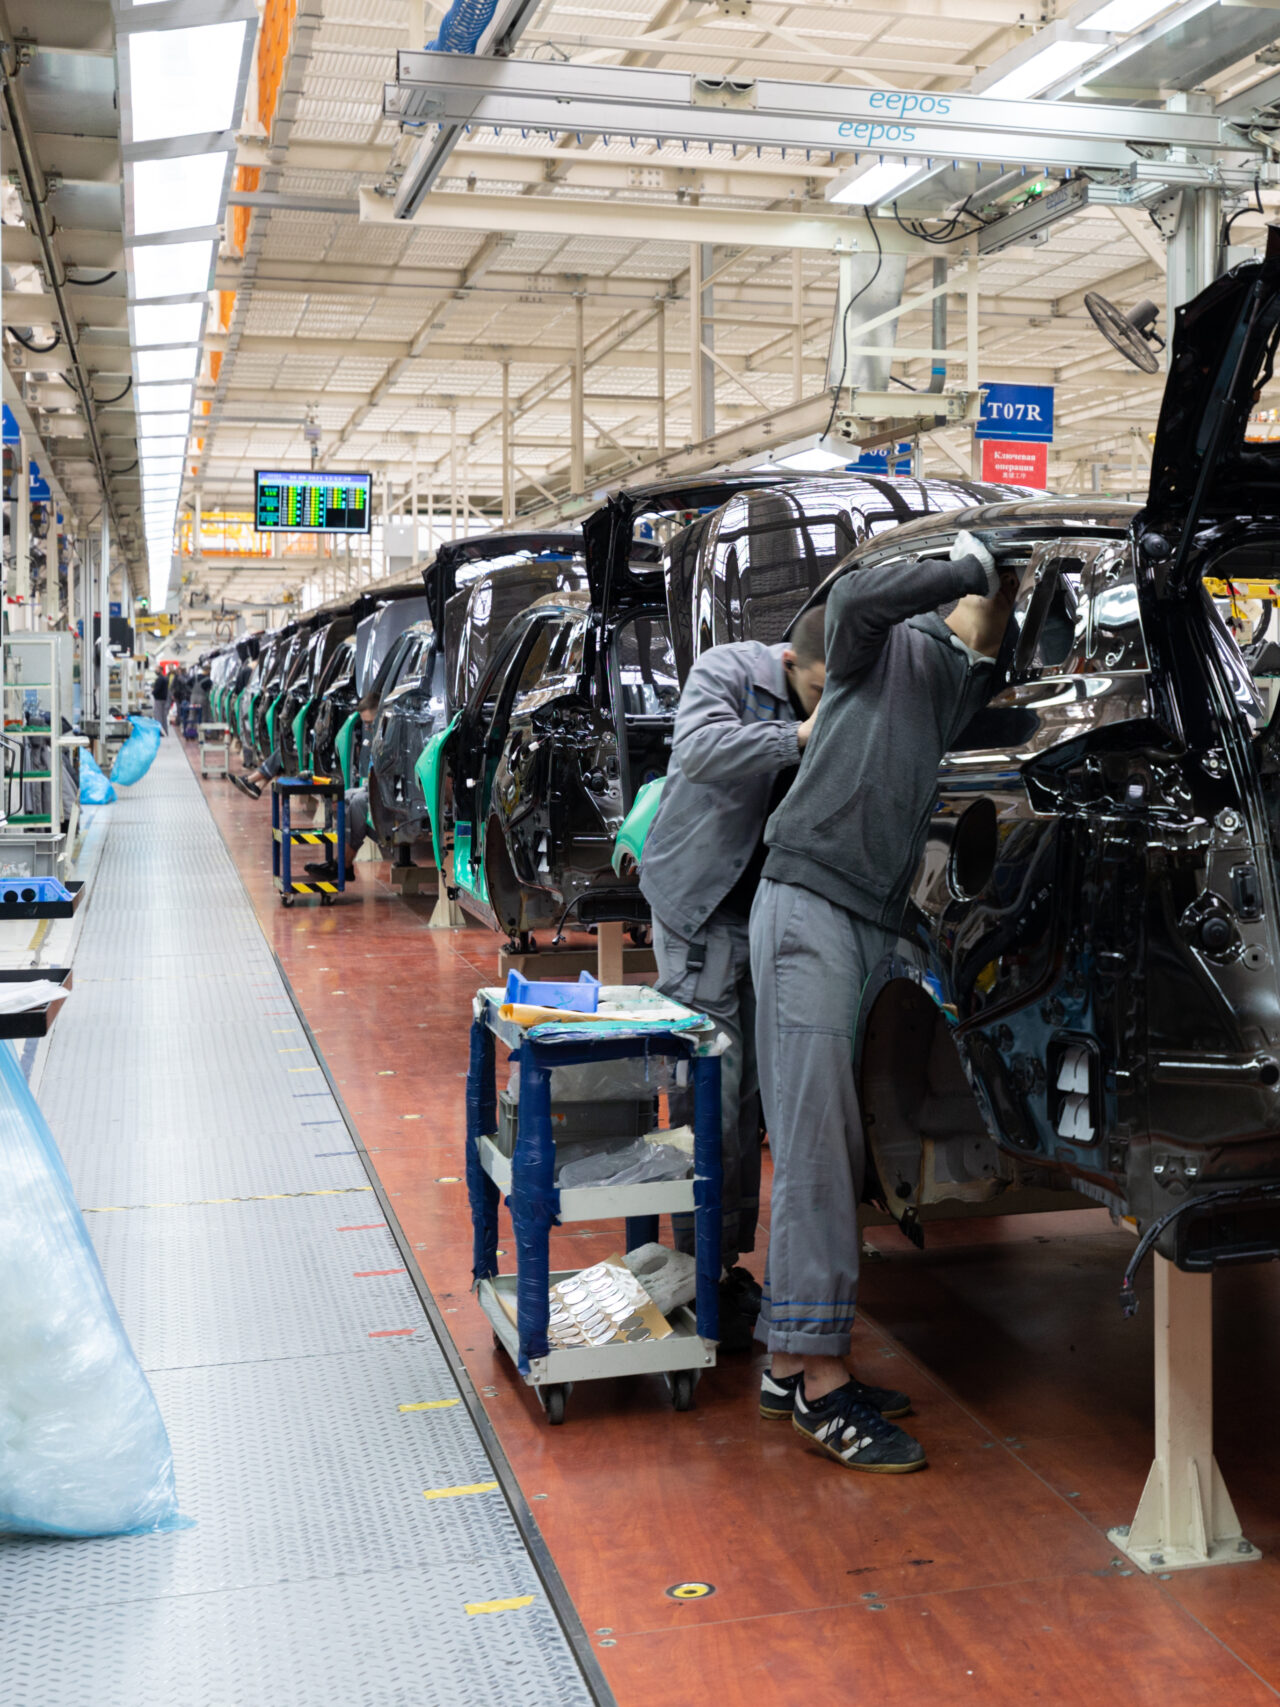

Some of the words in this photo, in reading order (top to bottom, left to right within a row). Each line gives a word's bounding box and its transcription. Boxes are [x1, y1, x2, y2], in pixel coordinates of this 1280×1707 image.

[869, 91, 952, 119] eepos
[838, 121, 917, 147] eepos
[987, 402, 1043, 421] T07R
